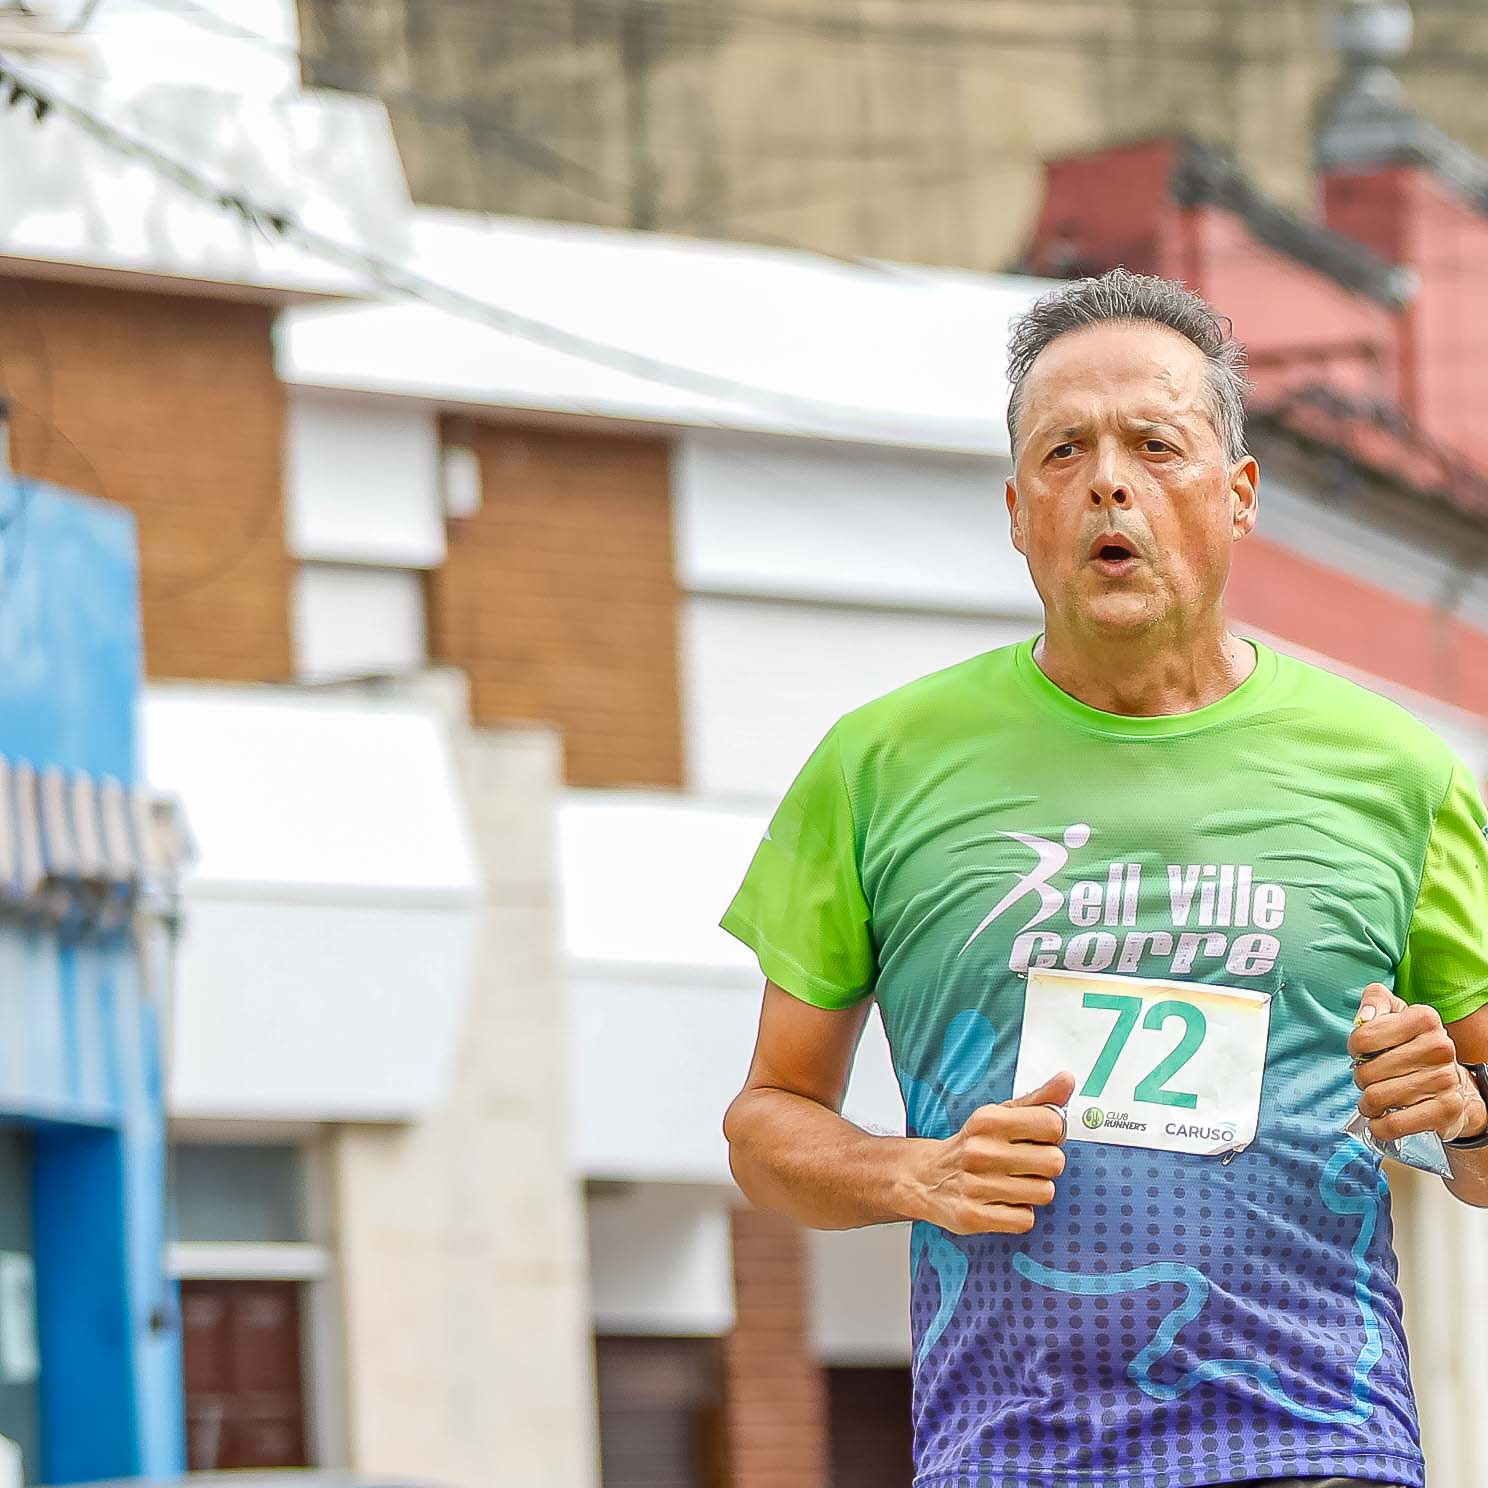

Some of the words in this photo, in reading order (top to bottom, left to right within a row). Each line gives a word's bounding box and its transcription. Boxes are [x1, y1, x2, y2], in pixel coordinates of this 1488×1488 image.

[1166, 863, 1286, 930] Ville
[1008, 931, 1281, 976] corre
[1078, 993, 1207, 1110] 72
[1106, 1111, 1129, 1121] CLUB
[1165, 1123, 1234, 1142] CARUSO
